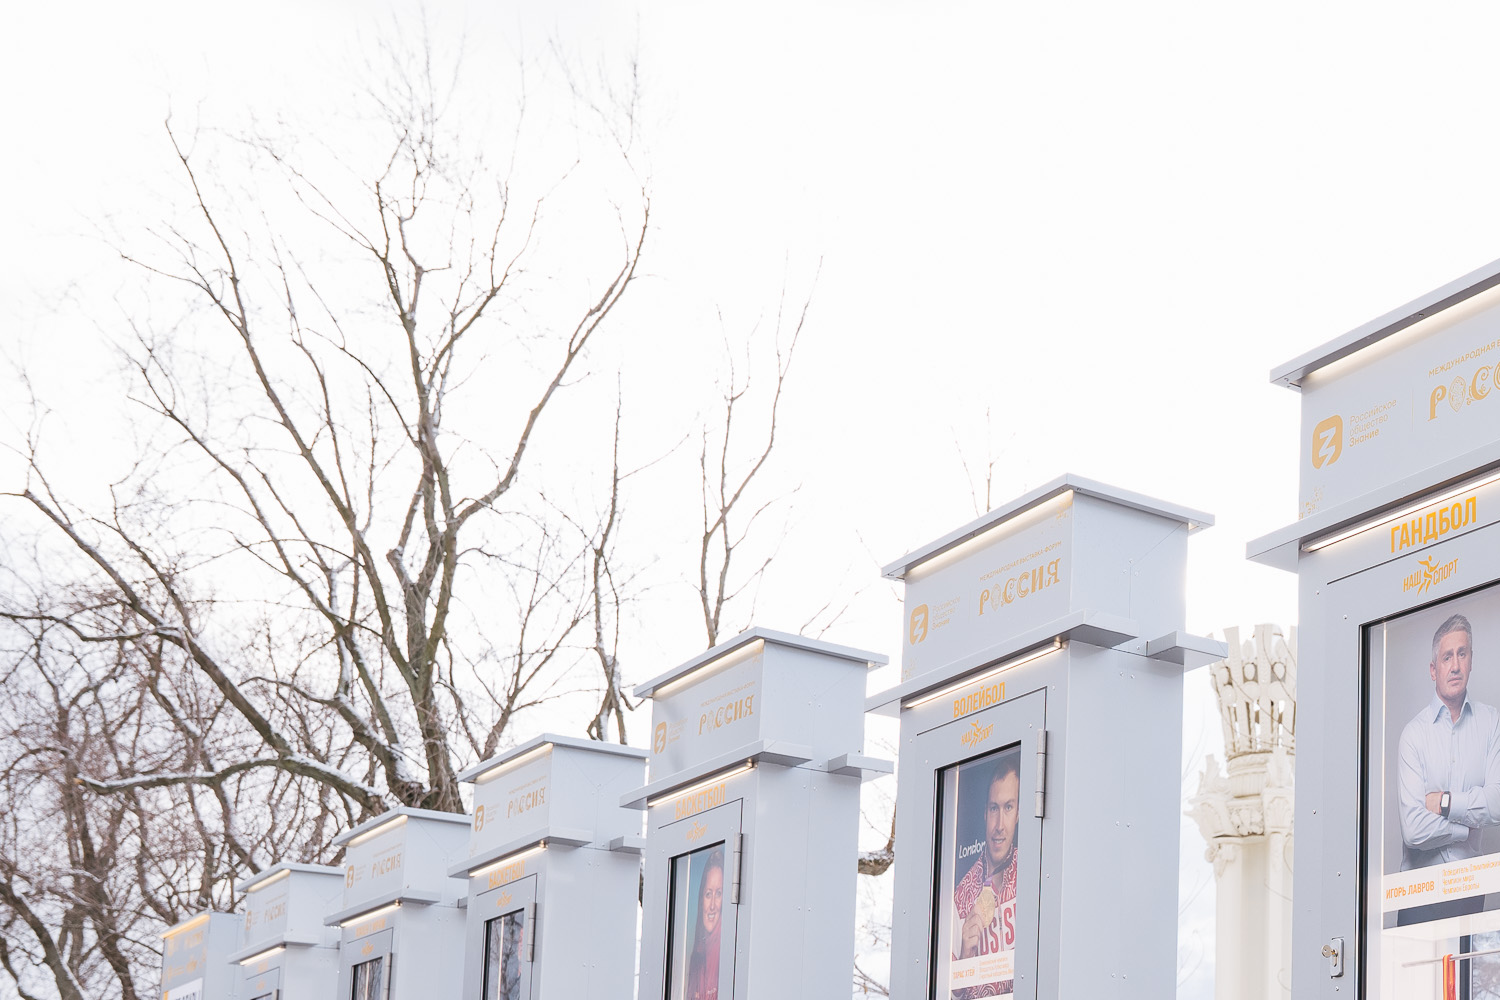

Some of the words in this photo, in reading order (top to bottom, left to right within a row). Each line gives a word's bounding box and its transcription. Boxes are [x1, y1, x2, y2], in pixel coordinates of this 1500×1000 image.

[1428, 340, 1496, 378] МЕЖДУНАРОДНАЯ
[1349, 399, 1397, 426] Российское
[1349, 413, 1389, 437] общество
[1349, 428, 1379, 447] Знание
[1390, 496, 1477, 553] ГАНДБОЛ
[978, 557, 1062, 616] РОССИЯ
[1403, 569, 1423, 593] НАШ
[1432, 558, 1459, 587] СПОРТ
[953, 681, 1006, 719] ВОЛЕЙБОЛ
[675, 783, 726, 820] БАСКЕТБОЛ
[1386, 886, 1407, 900] ИГОРЬ
[1407, 880, 1435, 896] ЛАВРОВ
